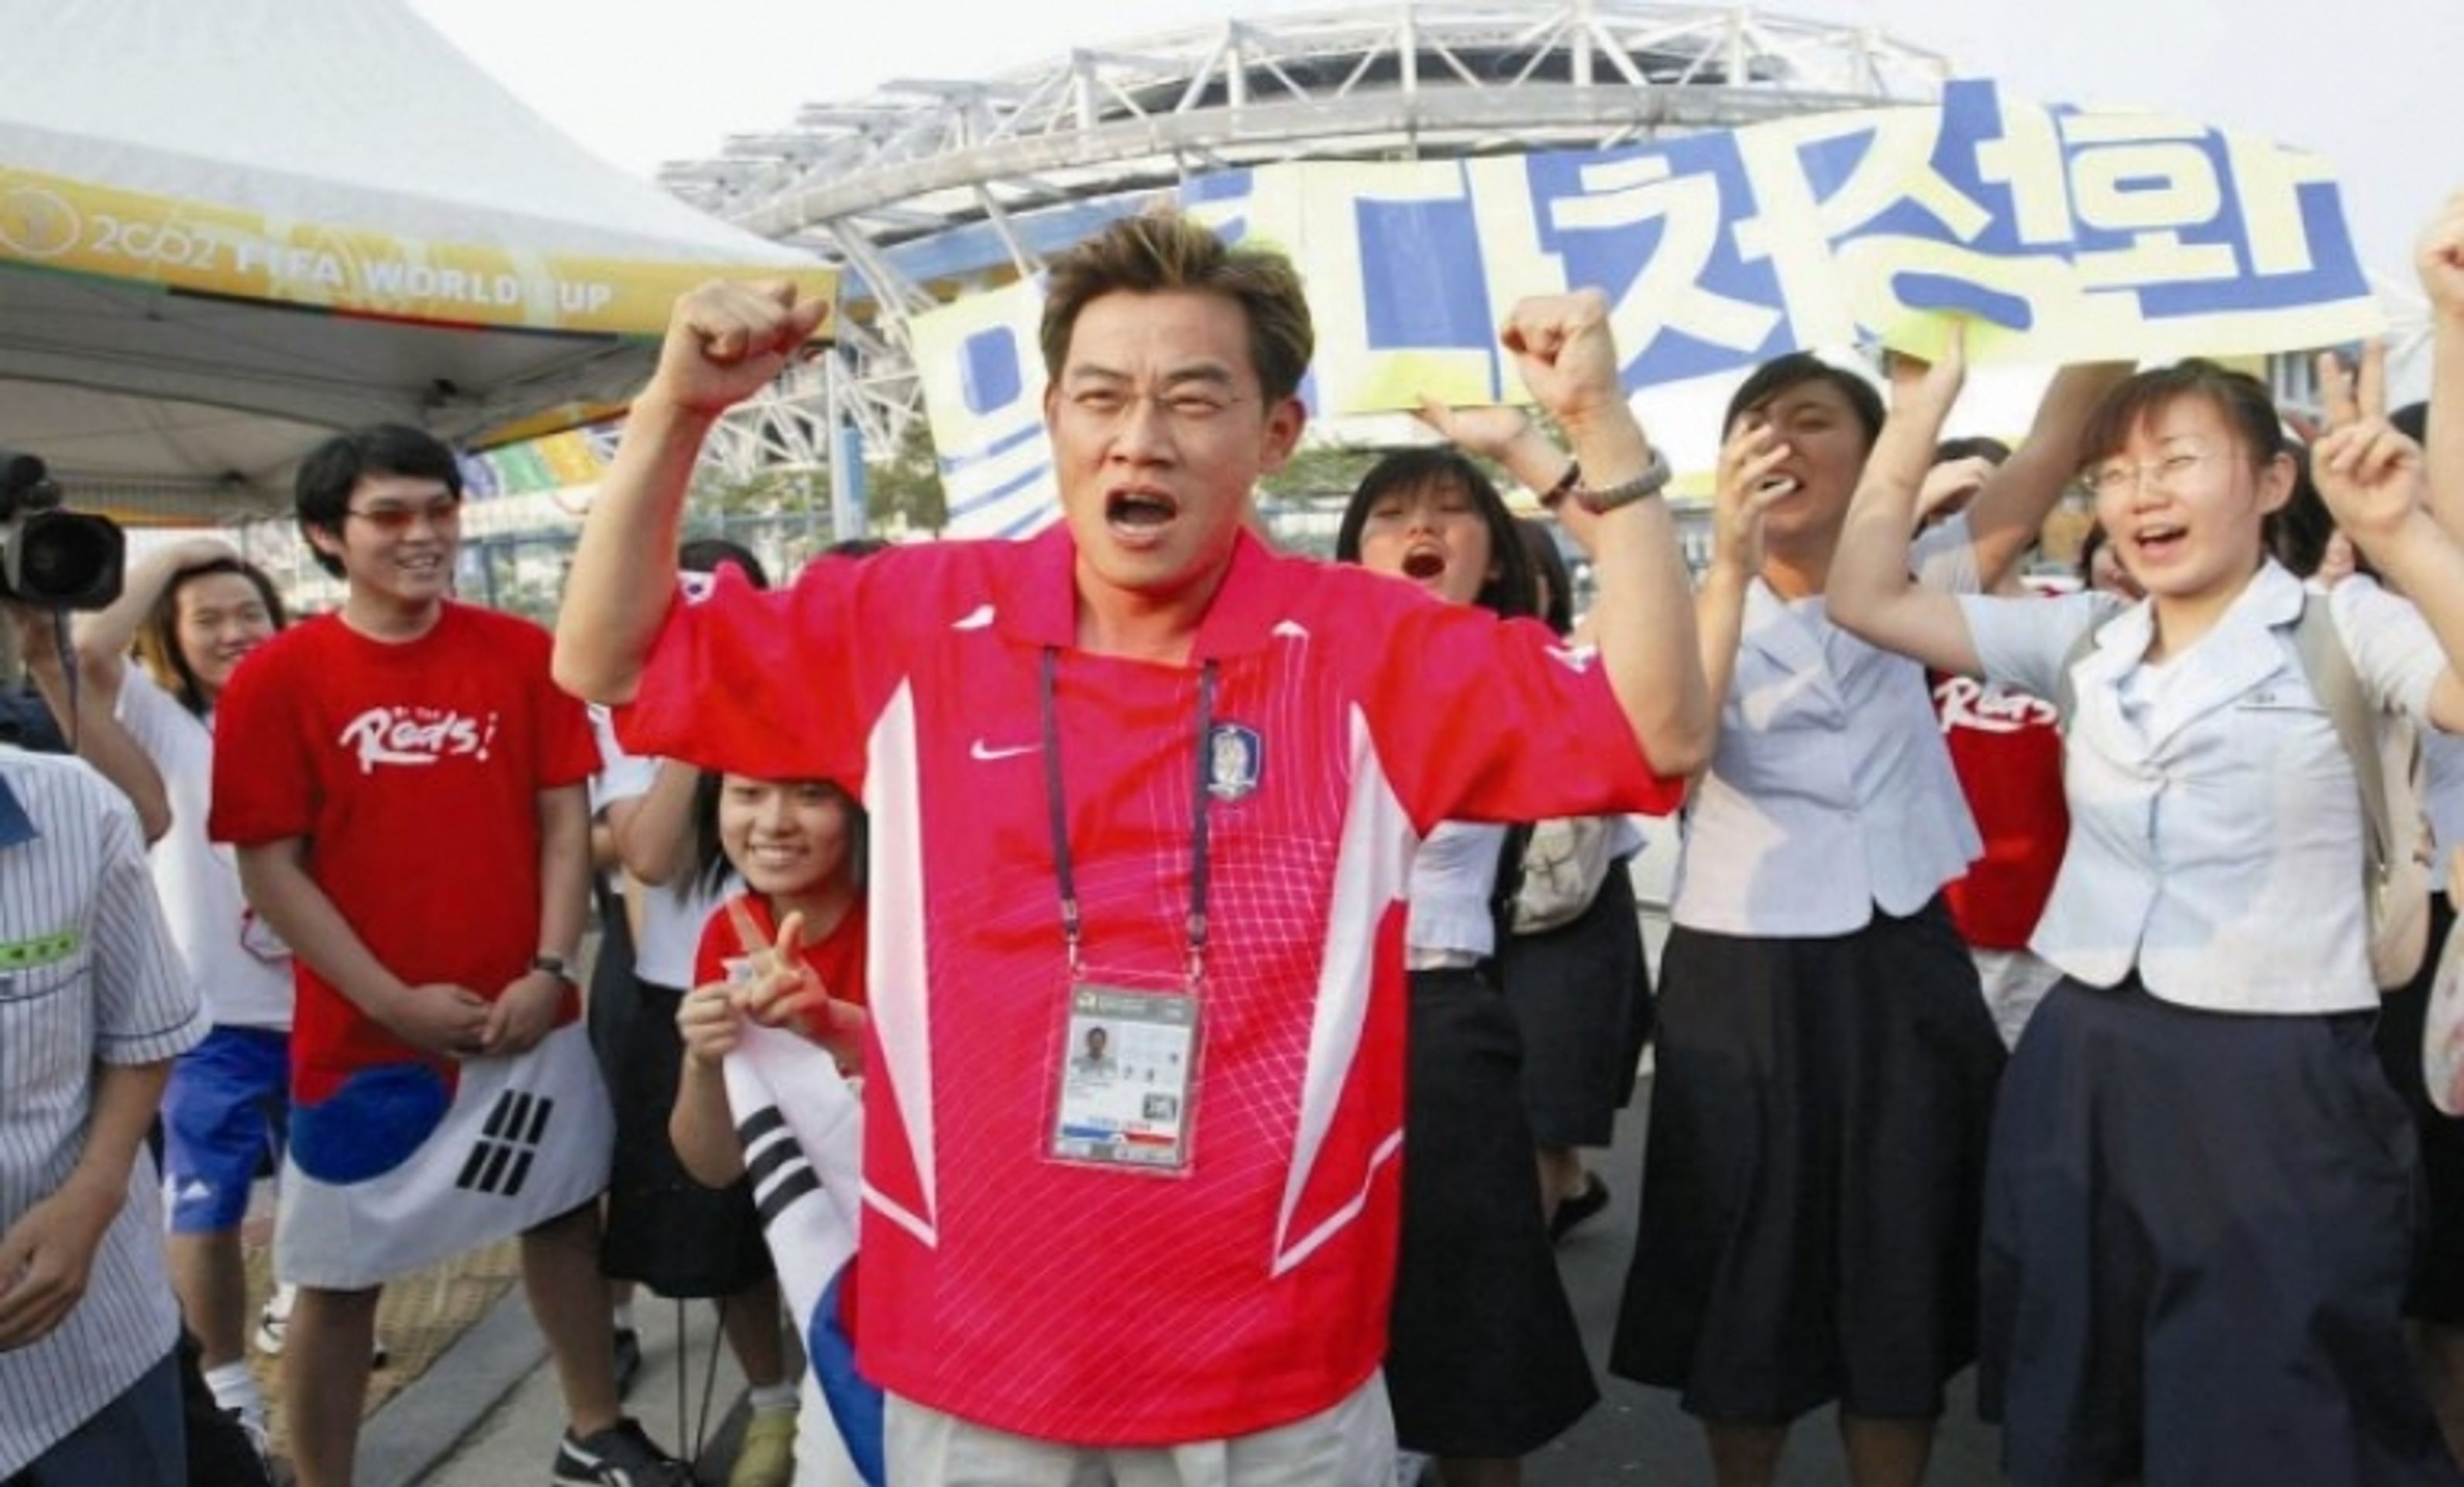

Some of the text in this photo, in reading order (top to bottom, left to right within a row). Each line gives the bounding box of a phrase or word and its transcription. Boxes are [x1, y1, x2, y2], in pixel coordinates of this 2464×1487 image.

[90, 214, 218, 271] 2002
[234, 242, 344, 287] FIFA
[362, 261, 518, 305] WORLD
